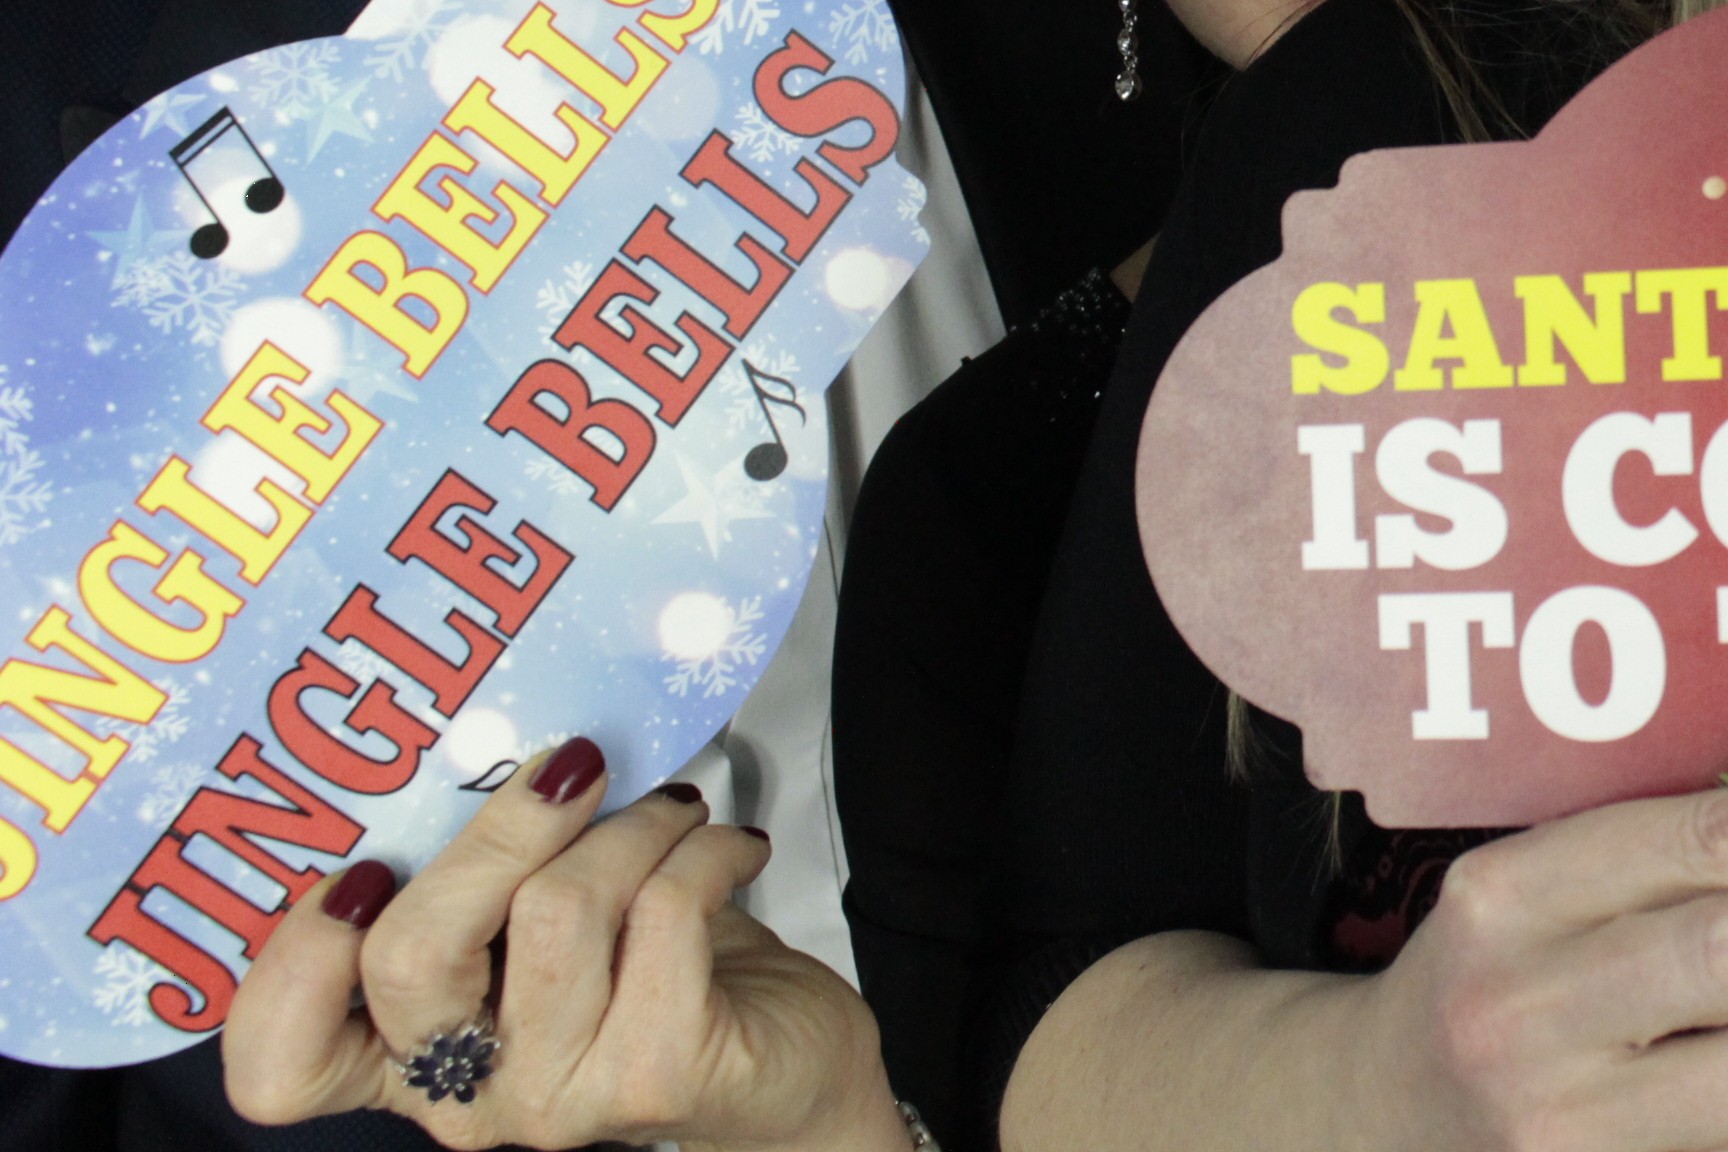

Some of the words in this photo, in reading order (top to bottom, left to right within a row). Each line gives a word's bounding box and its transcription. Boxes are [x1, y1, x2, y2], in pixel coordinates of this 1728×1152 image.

[86, 466, 575, 1033] JINGLE
[485, 29, 901, 512] BELLS
[1296, 417, 1510, 572] IS
[1377, 585, 1667, 743] TO
